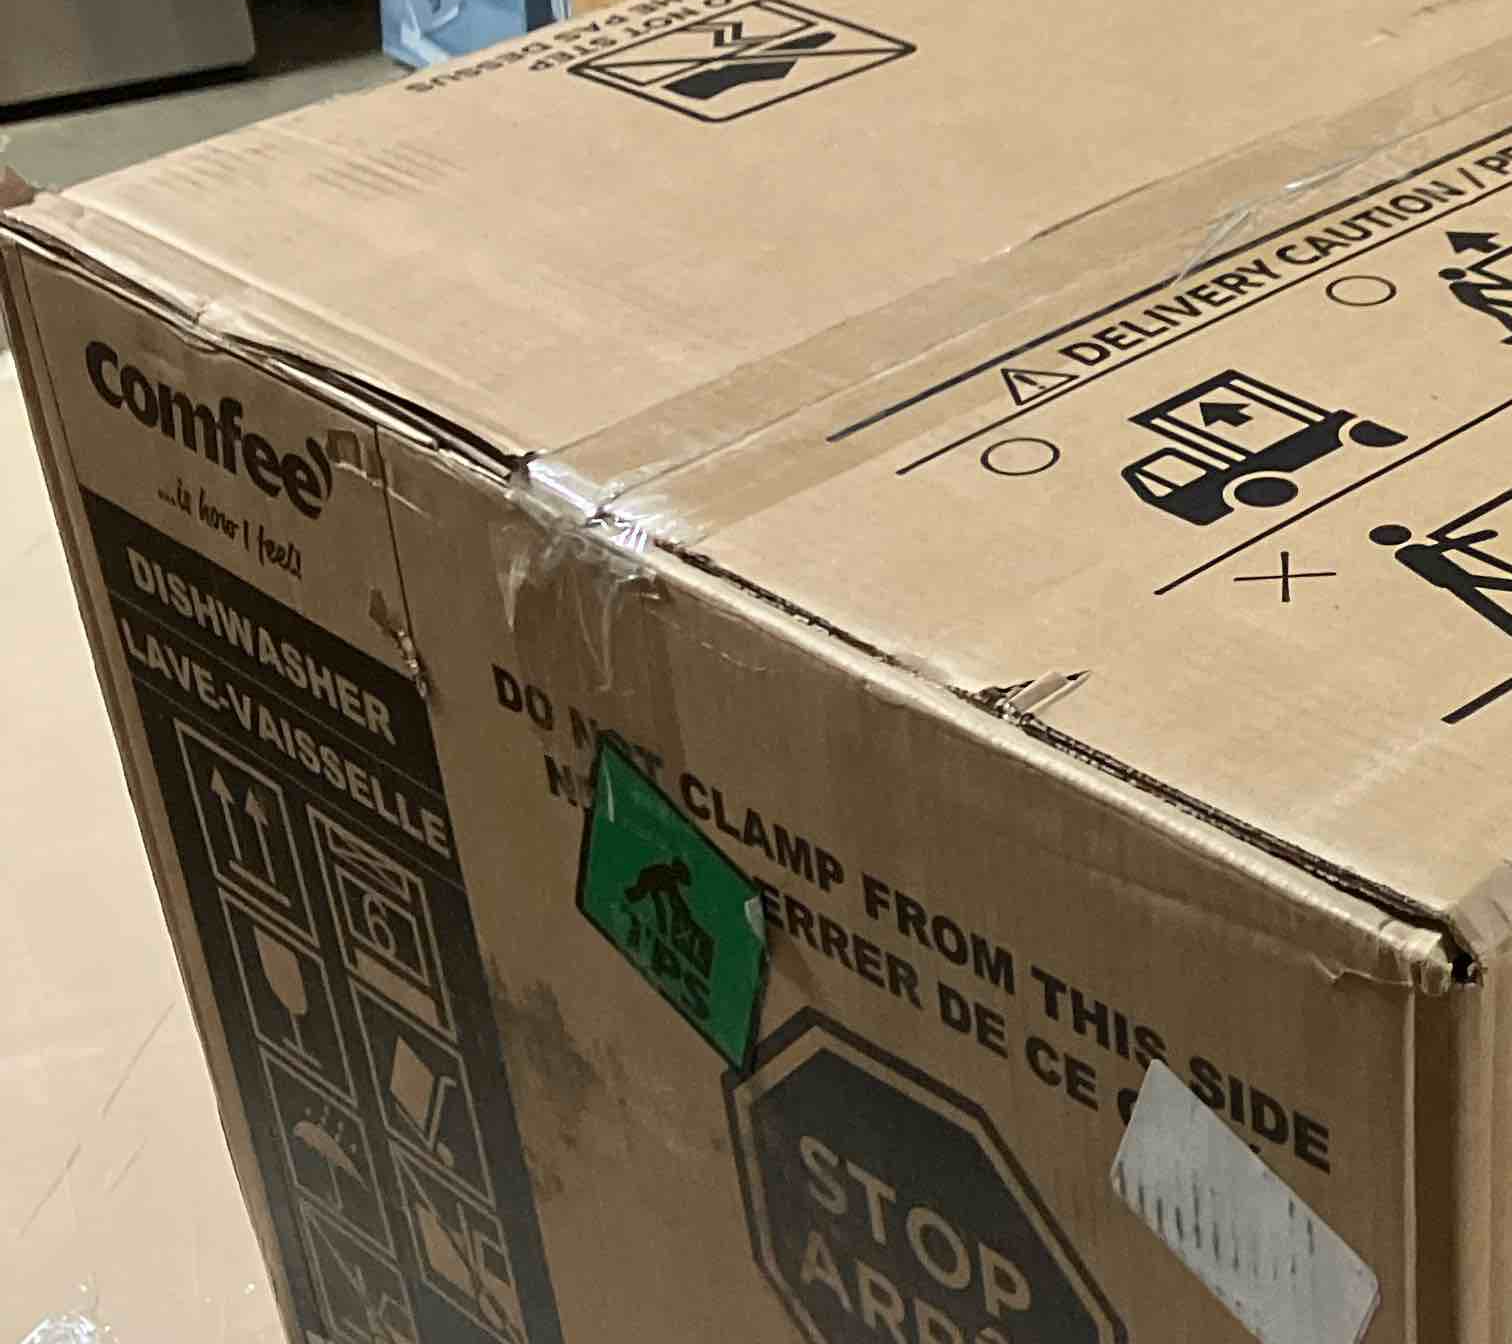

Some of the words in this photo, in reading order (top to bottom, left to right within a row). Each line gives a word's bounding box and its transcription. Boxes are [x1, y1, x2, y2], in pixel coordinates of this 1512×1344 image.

[405, 42, 551, 92] DESSUS
[528, 38, 617, 71] STEP
[553, 13, 629, 43] PAS
[630, 6, 700, 38] NOT
[1059, 259, 1282, 368] DELIVERY
[1276, 179, 1460, 271] CAUTION
[127, 545, 397, 744] DISHWASHER
[119, 617, 453, 858] LAVE-VAISSELLE
[491, 662, 553, 731] DO
[568, 705, 664, 778] NT
[680, 771, 845, 894] CLAMP
[861, 871, 1016, 997] FROM
[1030, 963, 1167, 1068] THIS
[1188, 1056, 1331, 1175] SIDE
[752, 876, 924, 1010] ERRER
[936, 978, 1009, 1059] DE
[1023, 1035, 1100, 1110] CE
[799, 1133, 1032, 1315] STOP
